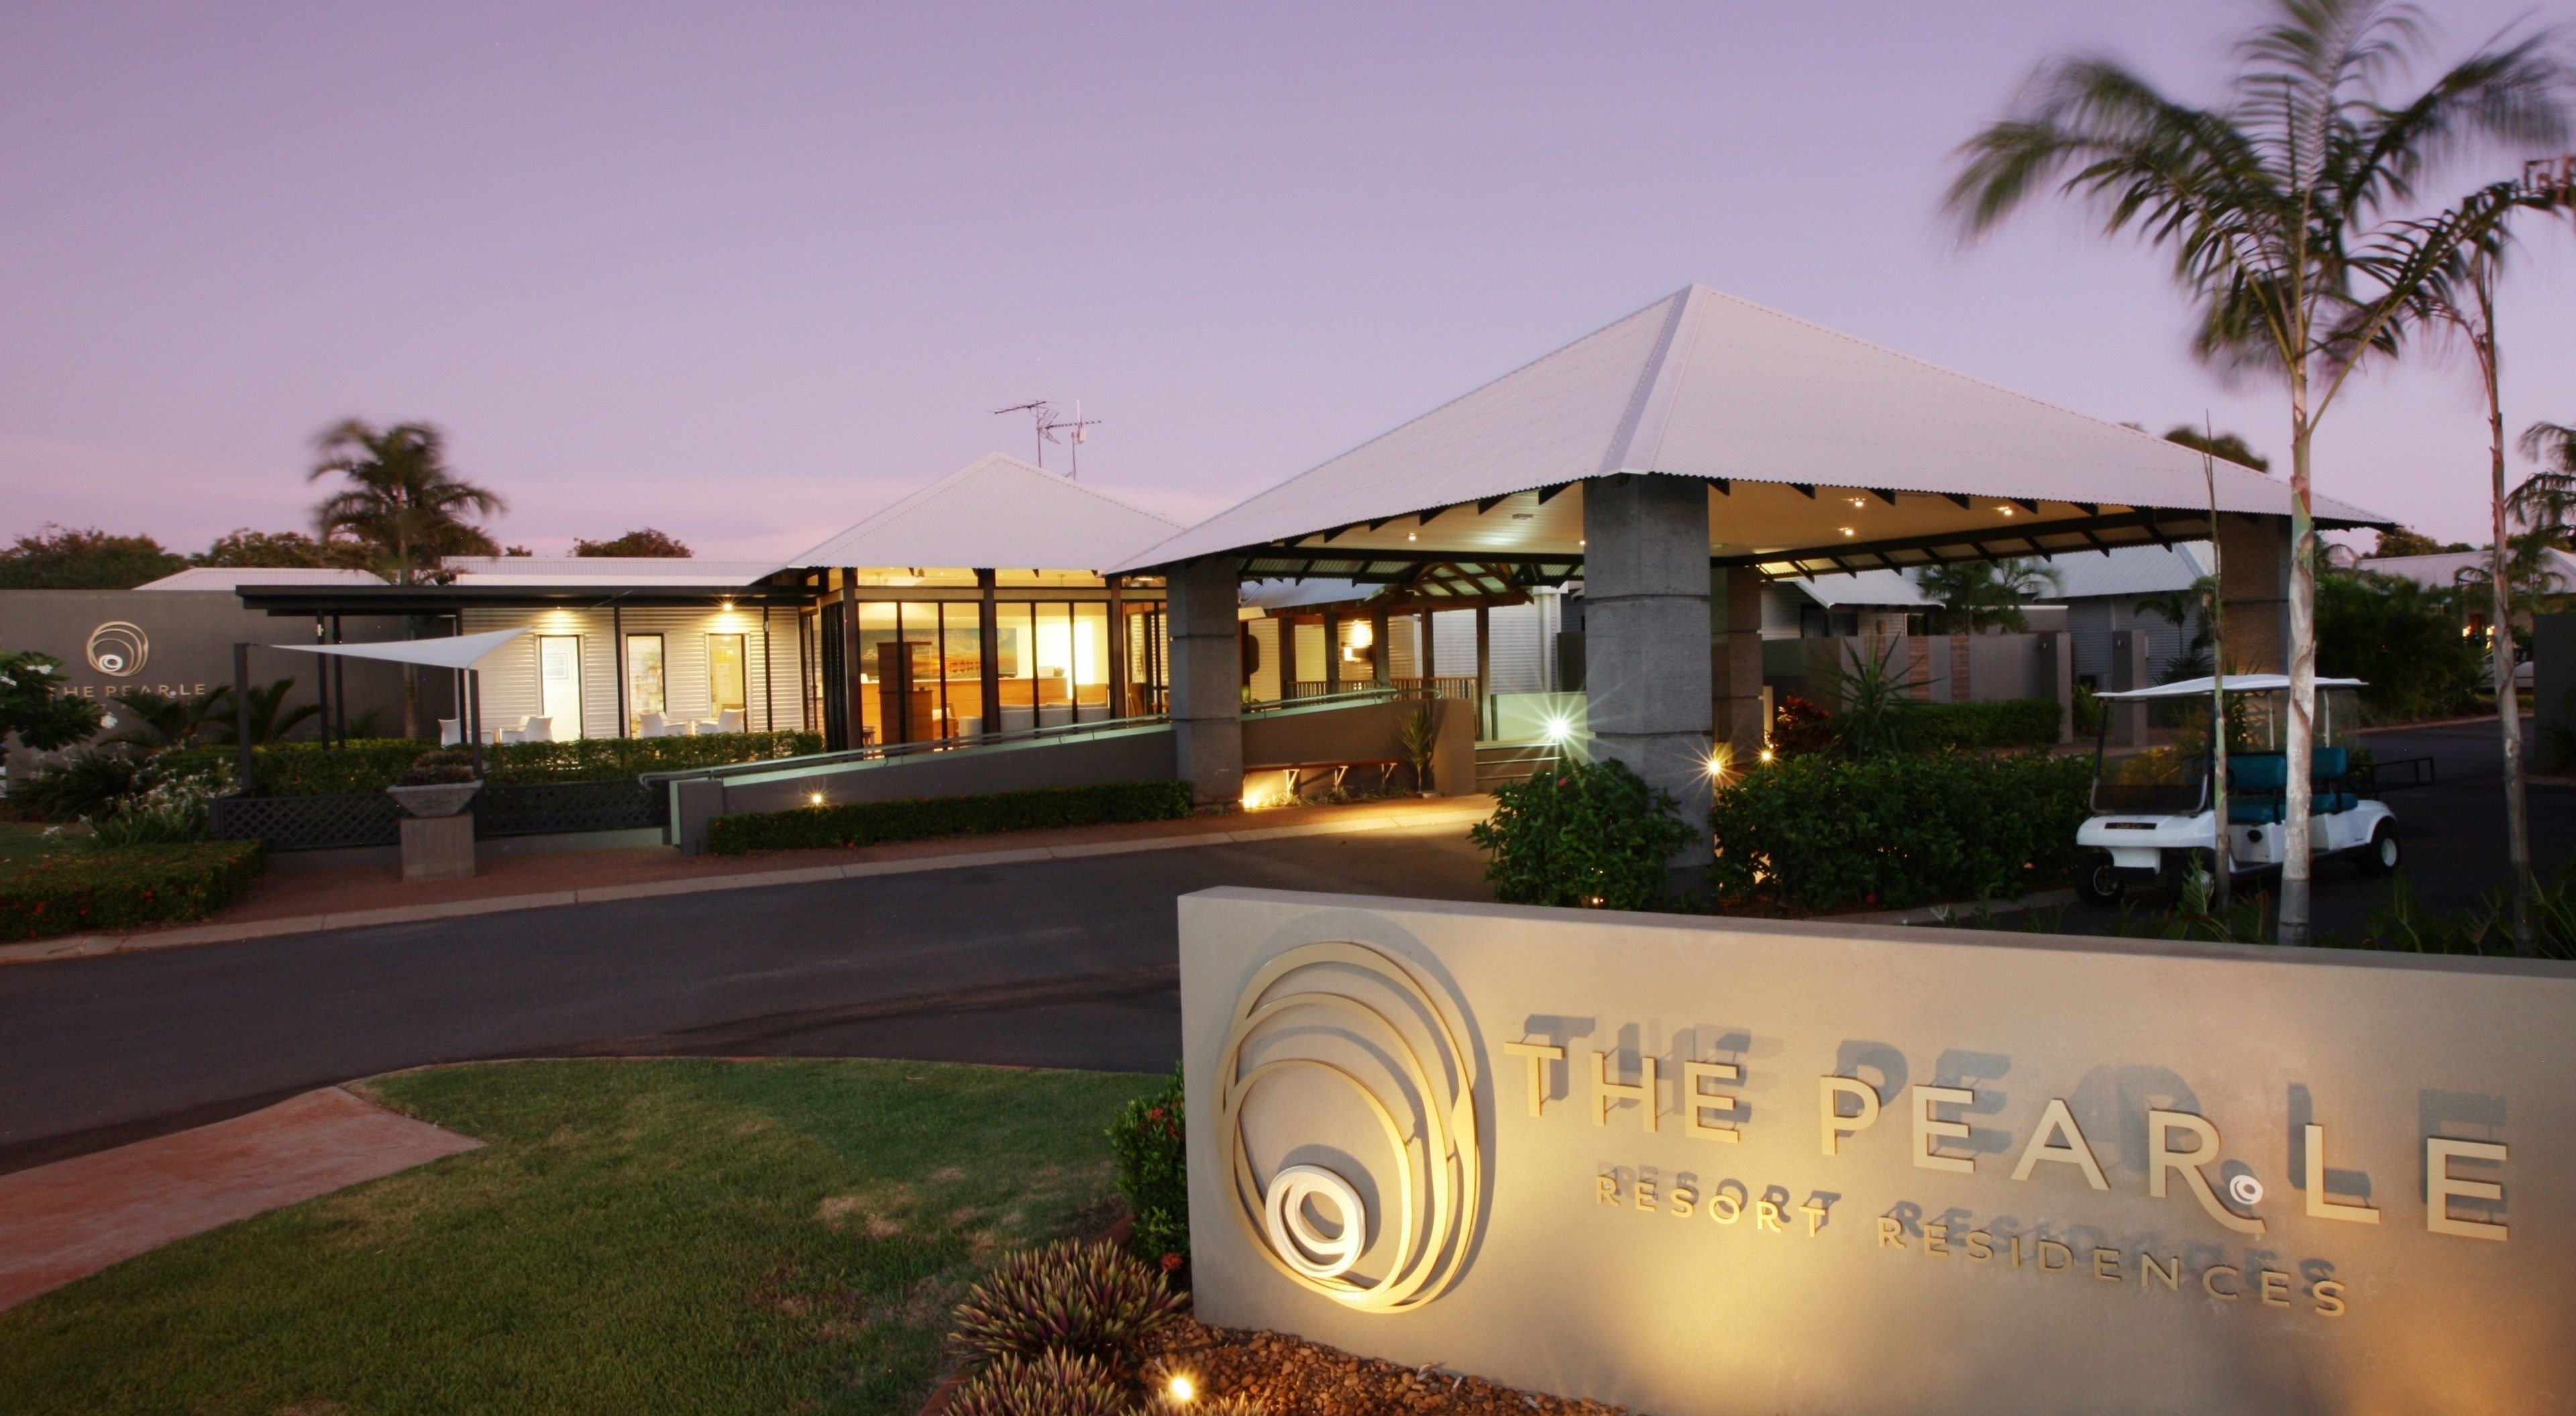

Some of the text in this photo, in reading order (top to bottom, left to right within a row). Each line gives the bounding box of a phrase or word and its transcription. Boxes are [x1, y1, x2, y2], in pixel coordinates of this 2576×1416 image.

[105, 684, 205, 698] PEARLE
[1503, 1041, 2509, 1242] THE PEARLE
[1596, 1175, 2347, 1318] RESORT RESIDENCES
